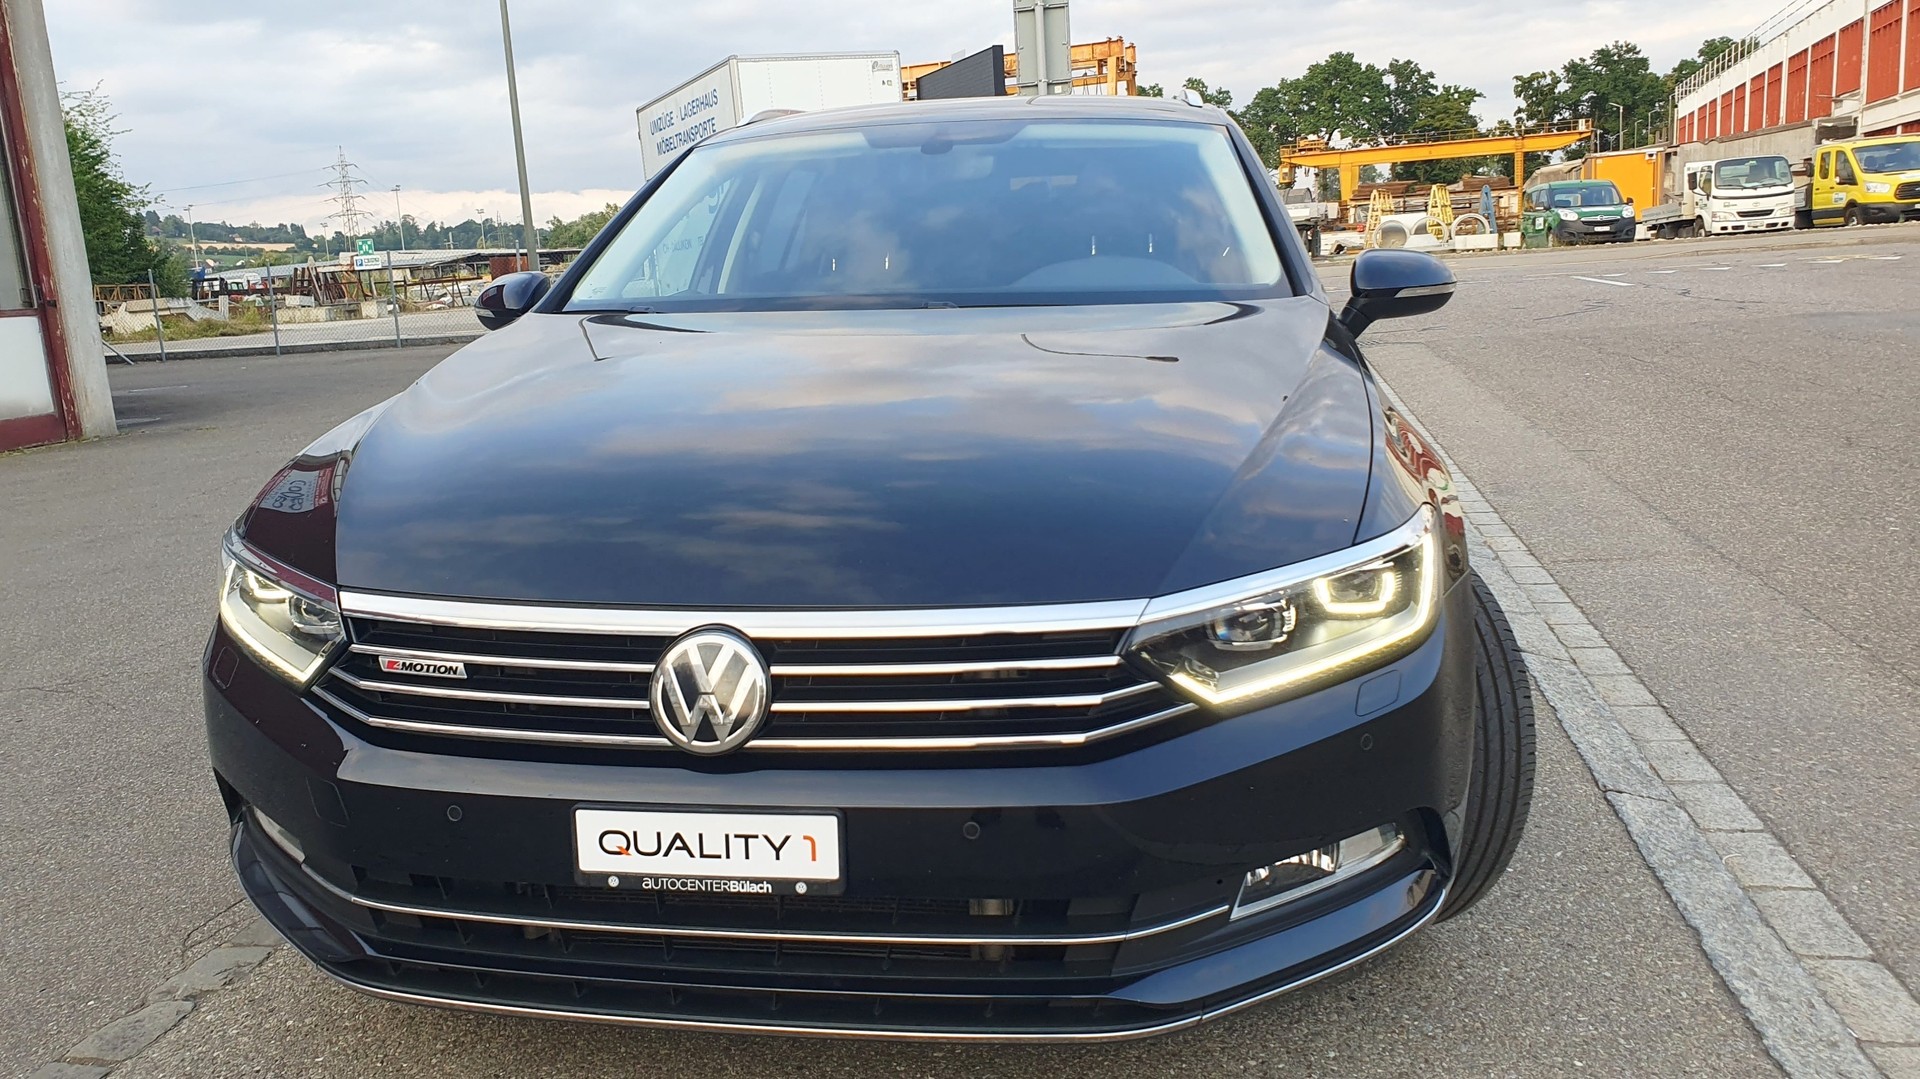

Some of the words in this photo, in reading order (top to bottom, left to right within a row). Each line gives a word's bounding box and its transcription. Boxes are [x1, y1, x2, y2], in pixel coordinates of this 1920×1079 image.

[649, 110, 675, 136] UMZÜGE
[679, 88, 719, 122] LAGERHAUS
[656, 116, 717, 157] MÖBELTRANSPORTE
[598, 828, 792, 862] QUALITY
[802, 834, 817, 862] 1
